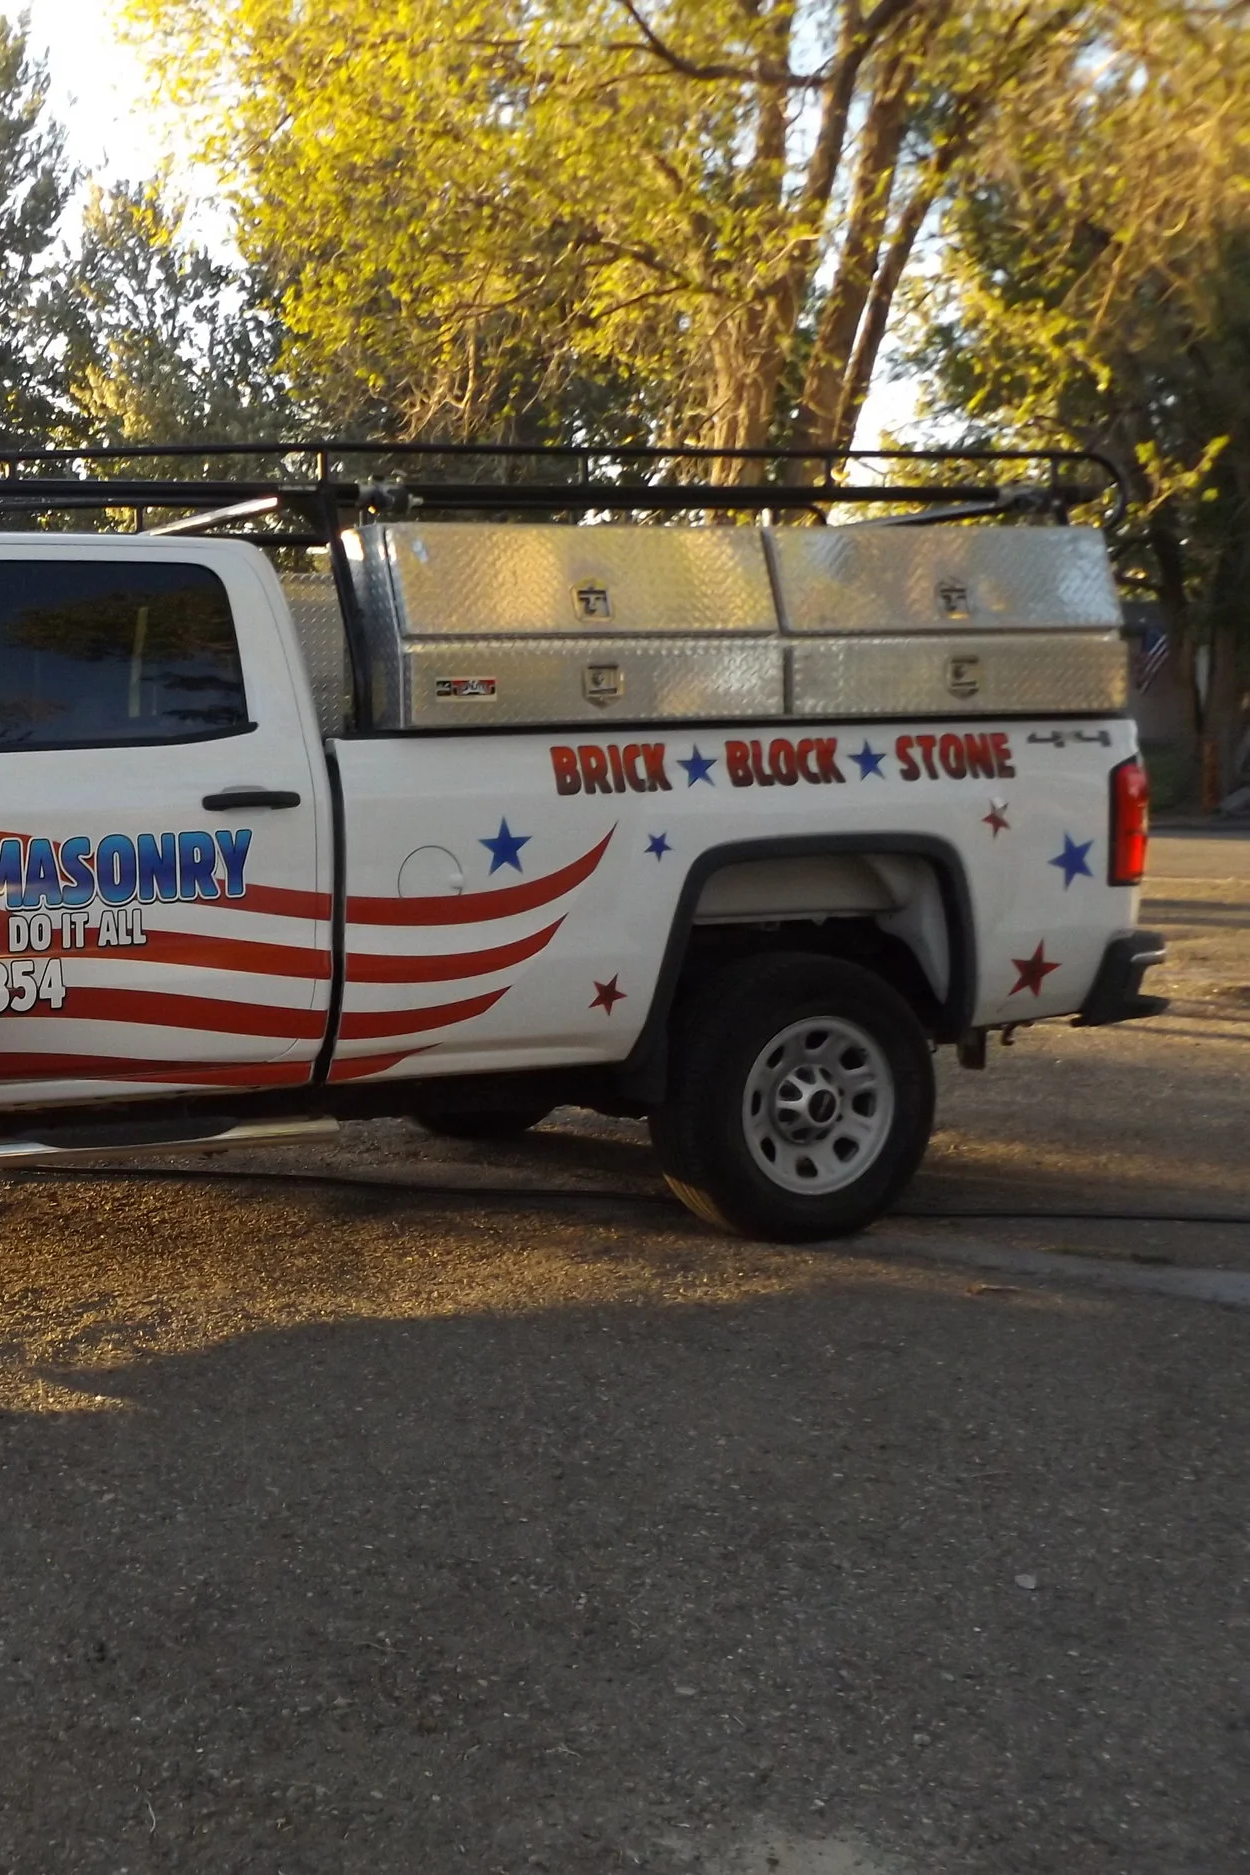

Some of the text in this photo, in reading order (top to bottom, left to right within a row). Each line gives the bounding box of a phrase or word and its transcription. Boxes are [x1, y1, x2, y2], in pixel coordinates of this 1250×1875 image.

[1027, 730, 1112, 748] 44
[550, 732, 1016, 796] BRICK BLOCK STONE
[8, 913, 52, 952] DO
[60, 912, 90, 949] IT
[97, 908, 147, 947] ALL
